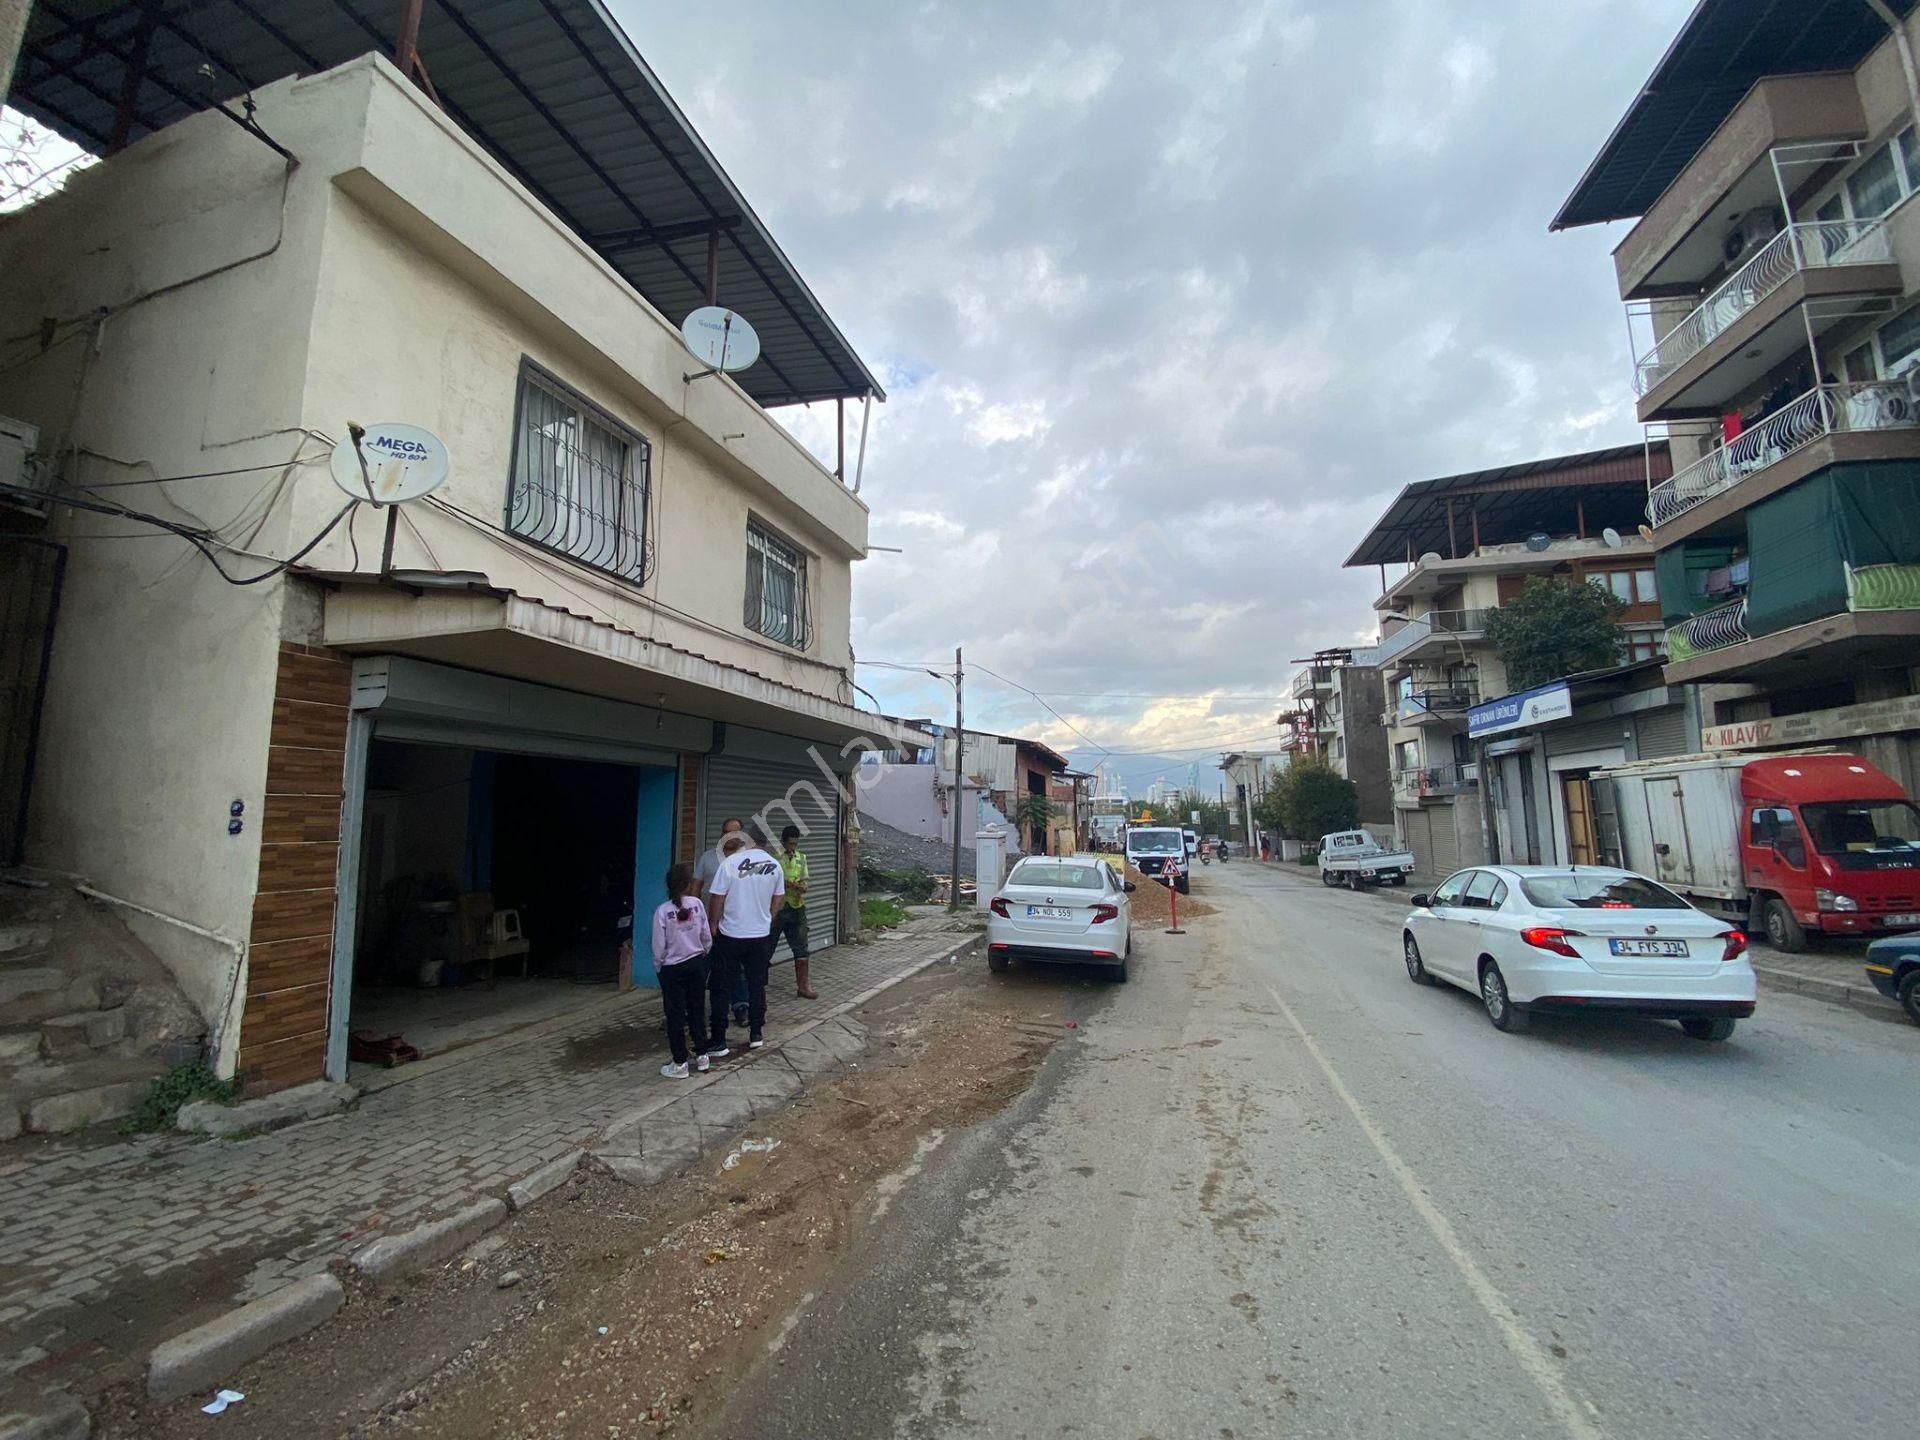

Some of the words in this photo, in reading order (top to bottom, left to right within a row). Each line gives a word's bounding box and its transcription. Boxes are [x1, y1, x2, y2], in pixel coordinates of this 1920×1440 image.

[376, 436, 427, 454] MEGA
[390, 451, 407, 460] HD
[1720, 722, 1774, 746] KILAVUZ
[1058, 908, 1071, 917] 559
[1617, 941, 1632, 952] 34
[1638, 942, 1660, 953] FYS
[1664, 942, 1684, 953] 334
